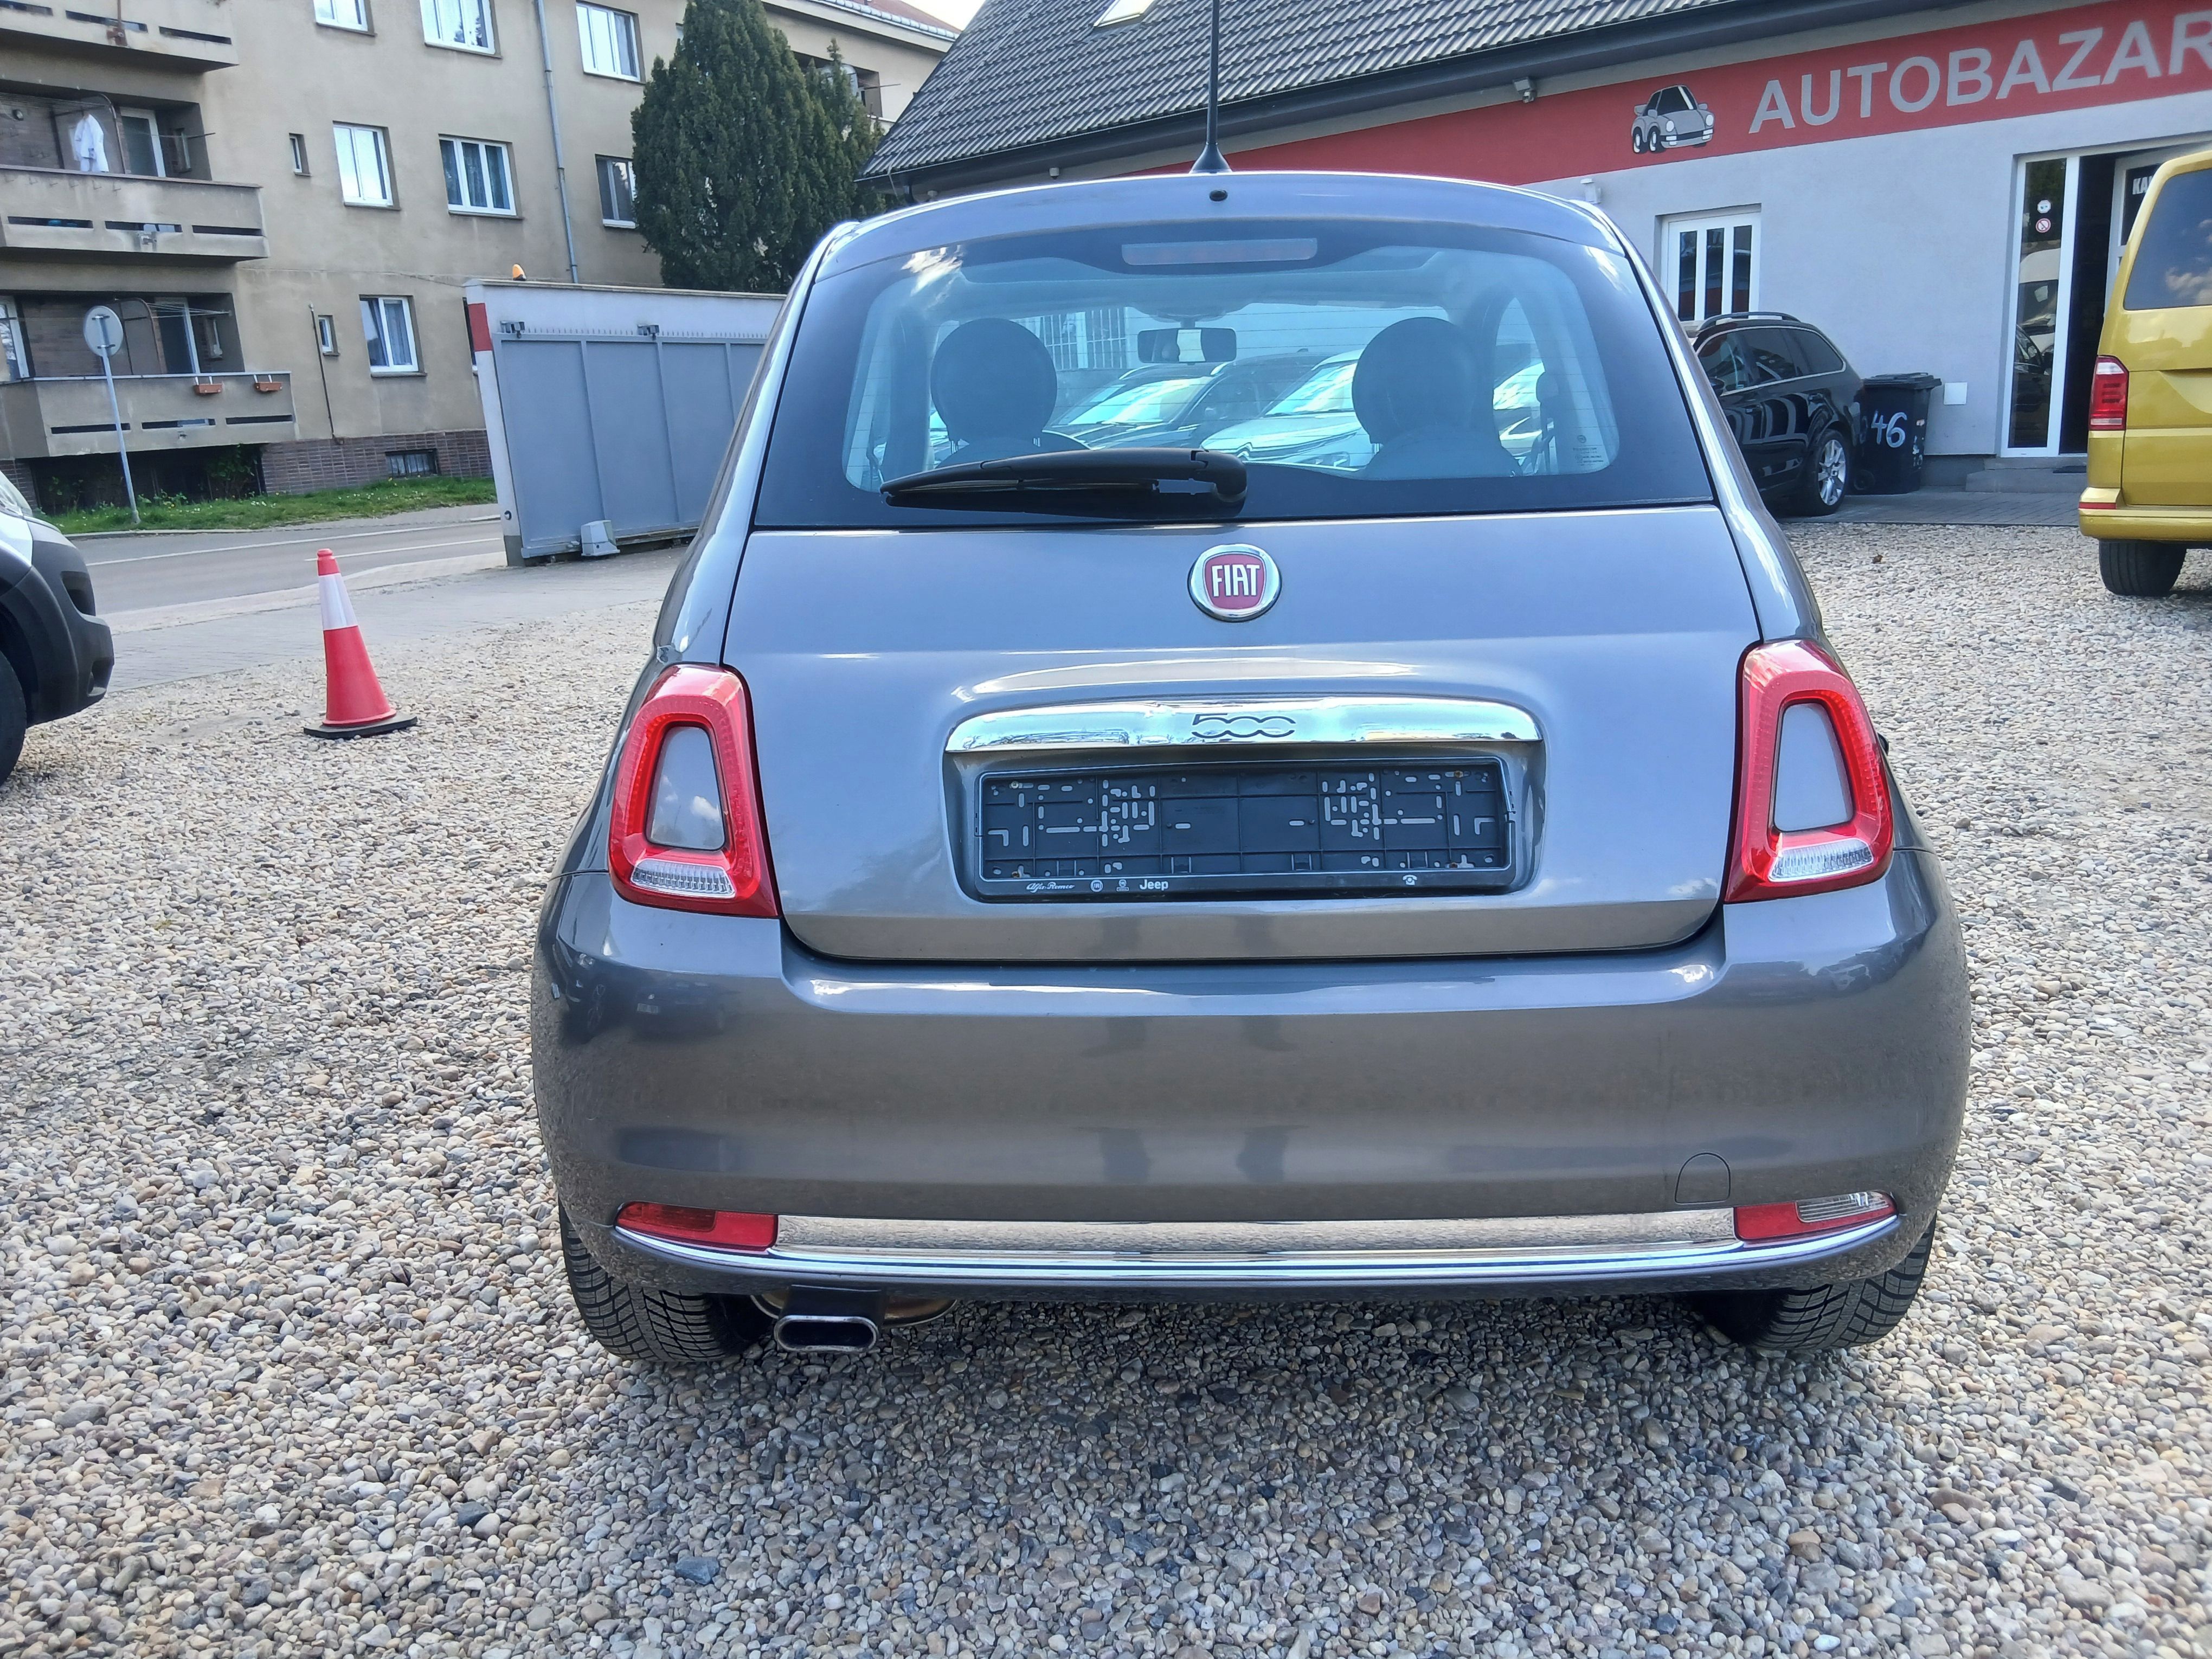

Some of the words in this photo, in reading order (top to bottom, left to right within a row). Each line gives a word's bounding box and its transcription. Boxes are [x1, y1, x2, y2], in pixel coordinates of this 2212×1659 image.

[1749, 9, 2212, 134] AUTOBAZAR
[1871, 410, 1907, 448] 46
[1212, 564, 1260, 597] FIAT
[1192, 713, 1296, 738] 500
[1026, 883, 1046, 893] Alfa
[1140, 879, 1168, 891] Jeep
